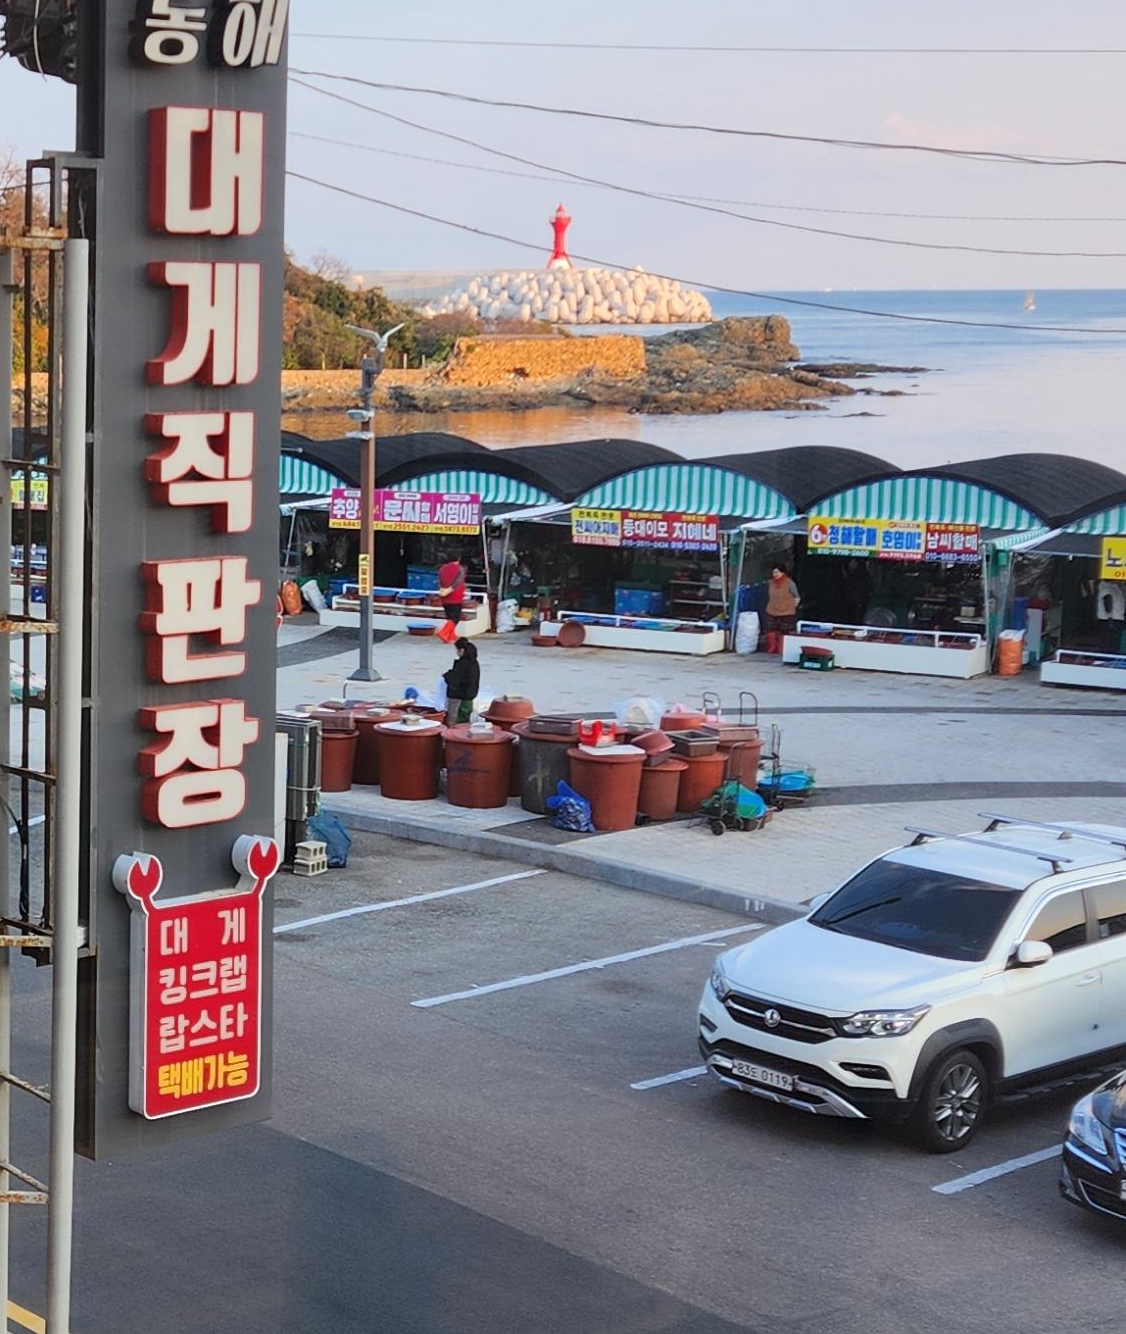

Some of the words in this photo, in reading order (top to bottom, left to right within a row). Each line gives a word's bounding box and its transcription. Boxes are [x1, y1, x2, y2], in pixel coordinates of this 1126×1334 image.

[152, 106, 263, 828] 대게직판장
[159, 954, 247, 1005] 킹크랩
[159, 1002, 248, 1054] 랍스타
[158, 1051, 249, 1099] 택배가능
